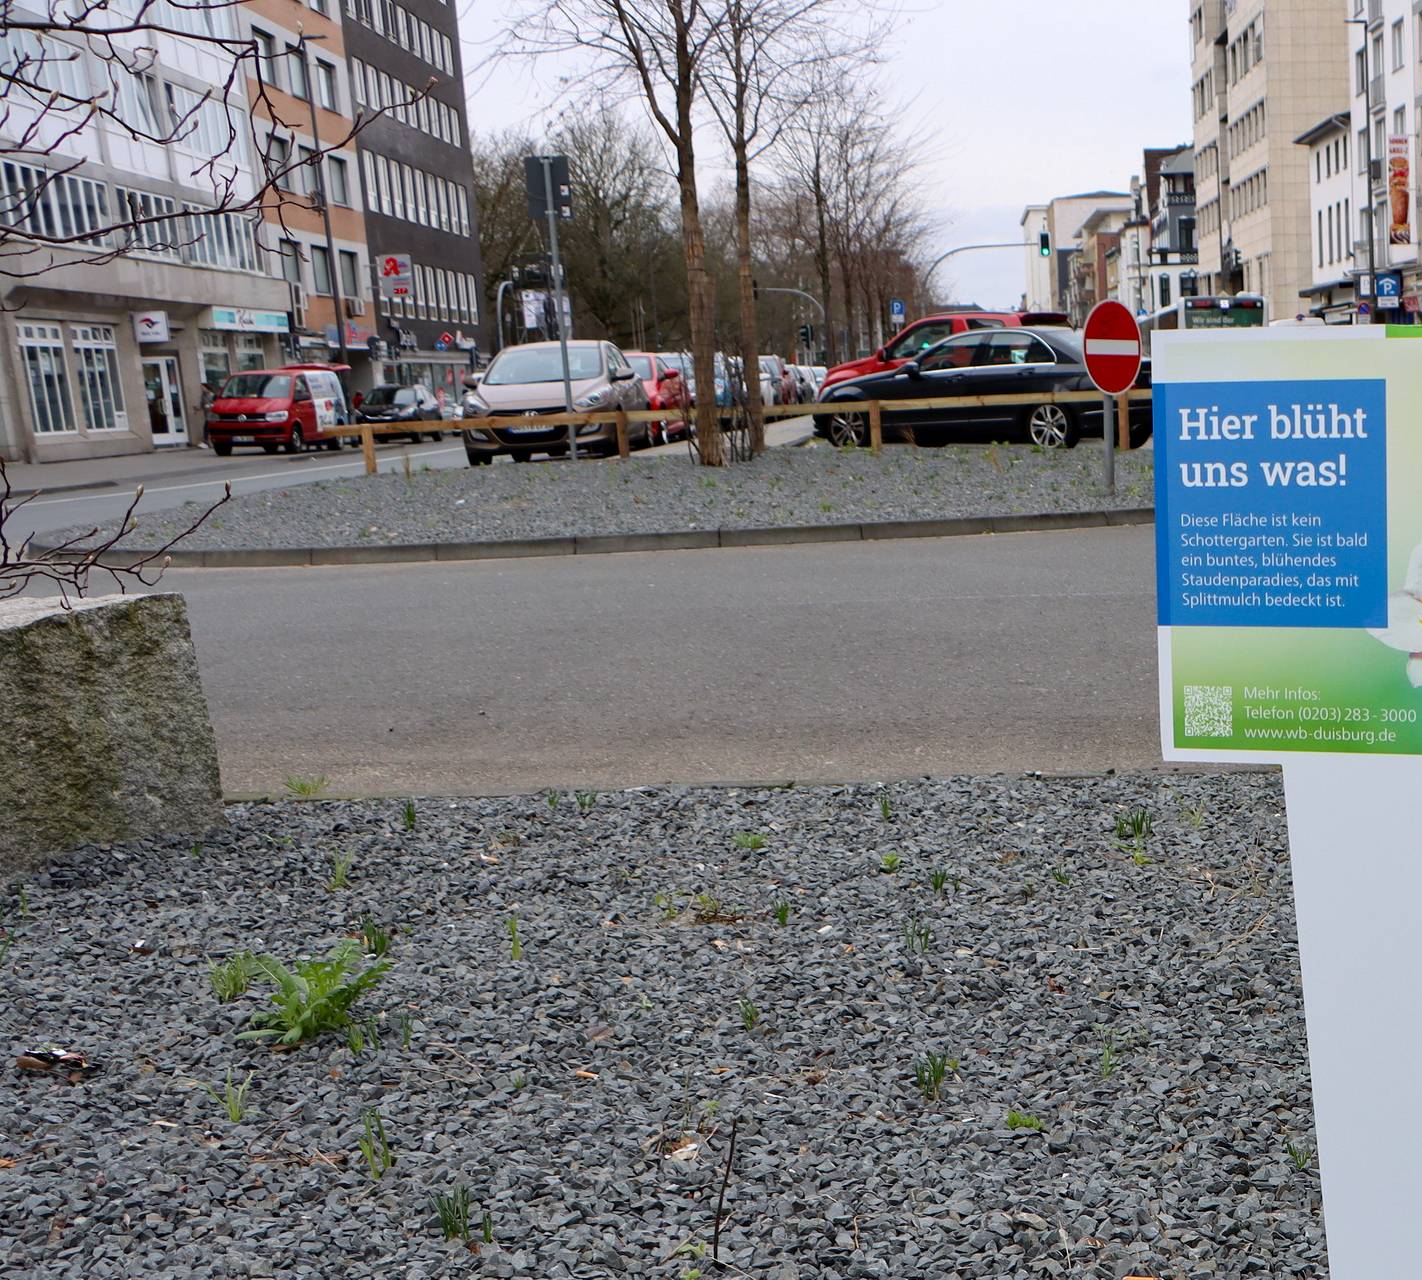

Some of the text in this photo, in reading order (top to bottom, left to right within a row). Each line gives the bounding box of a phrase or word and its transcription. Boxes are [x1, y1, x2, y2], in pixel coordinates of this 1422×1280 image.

[1179, 404, 1368, 441] Hier blüht
[1180, 453, 1347, 488] uns was!
[1181, 512, 1321, 527] Diese Fläche ist kein
[1181, 532, 1368, 550] Schottergarten. Sie ist bald
[1181, 552, 1337, 568] ein buntes, blühendes
[1182, 573, 1359, 589] Staudenparadies, das mit
[1182, 592, 1345, 609] Splittmulch bedeckt ist.
[1244, 686, 1321, 701] Mehr Infos:
[1244, 706, 1294, 720] Telefon
[1298, 706, 1341, 723] (0203)
[1244, 726, 1397, 744] www.wb-duisburg.de
